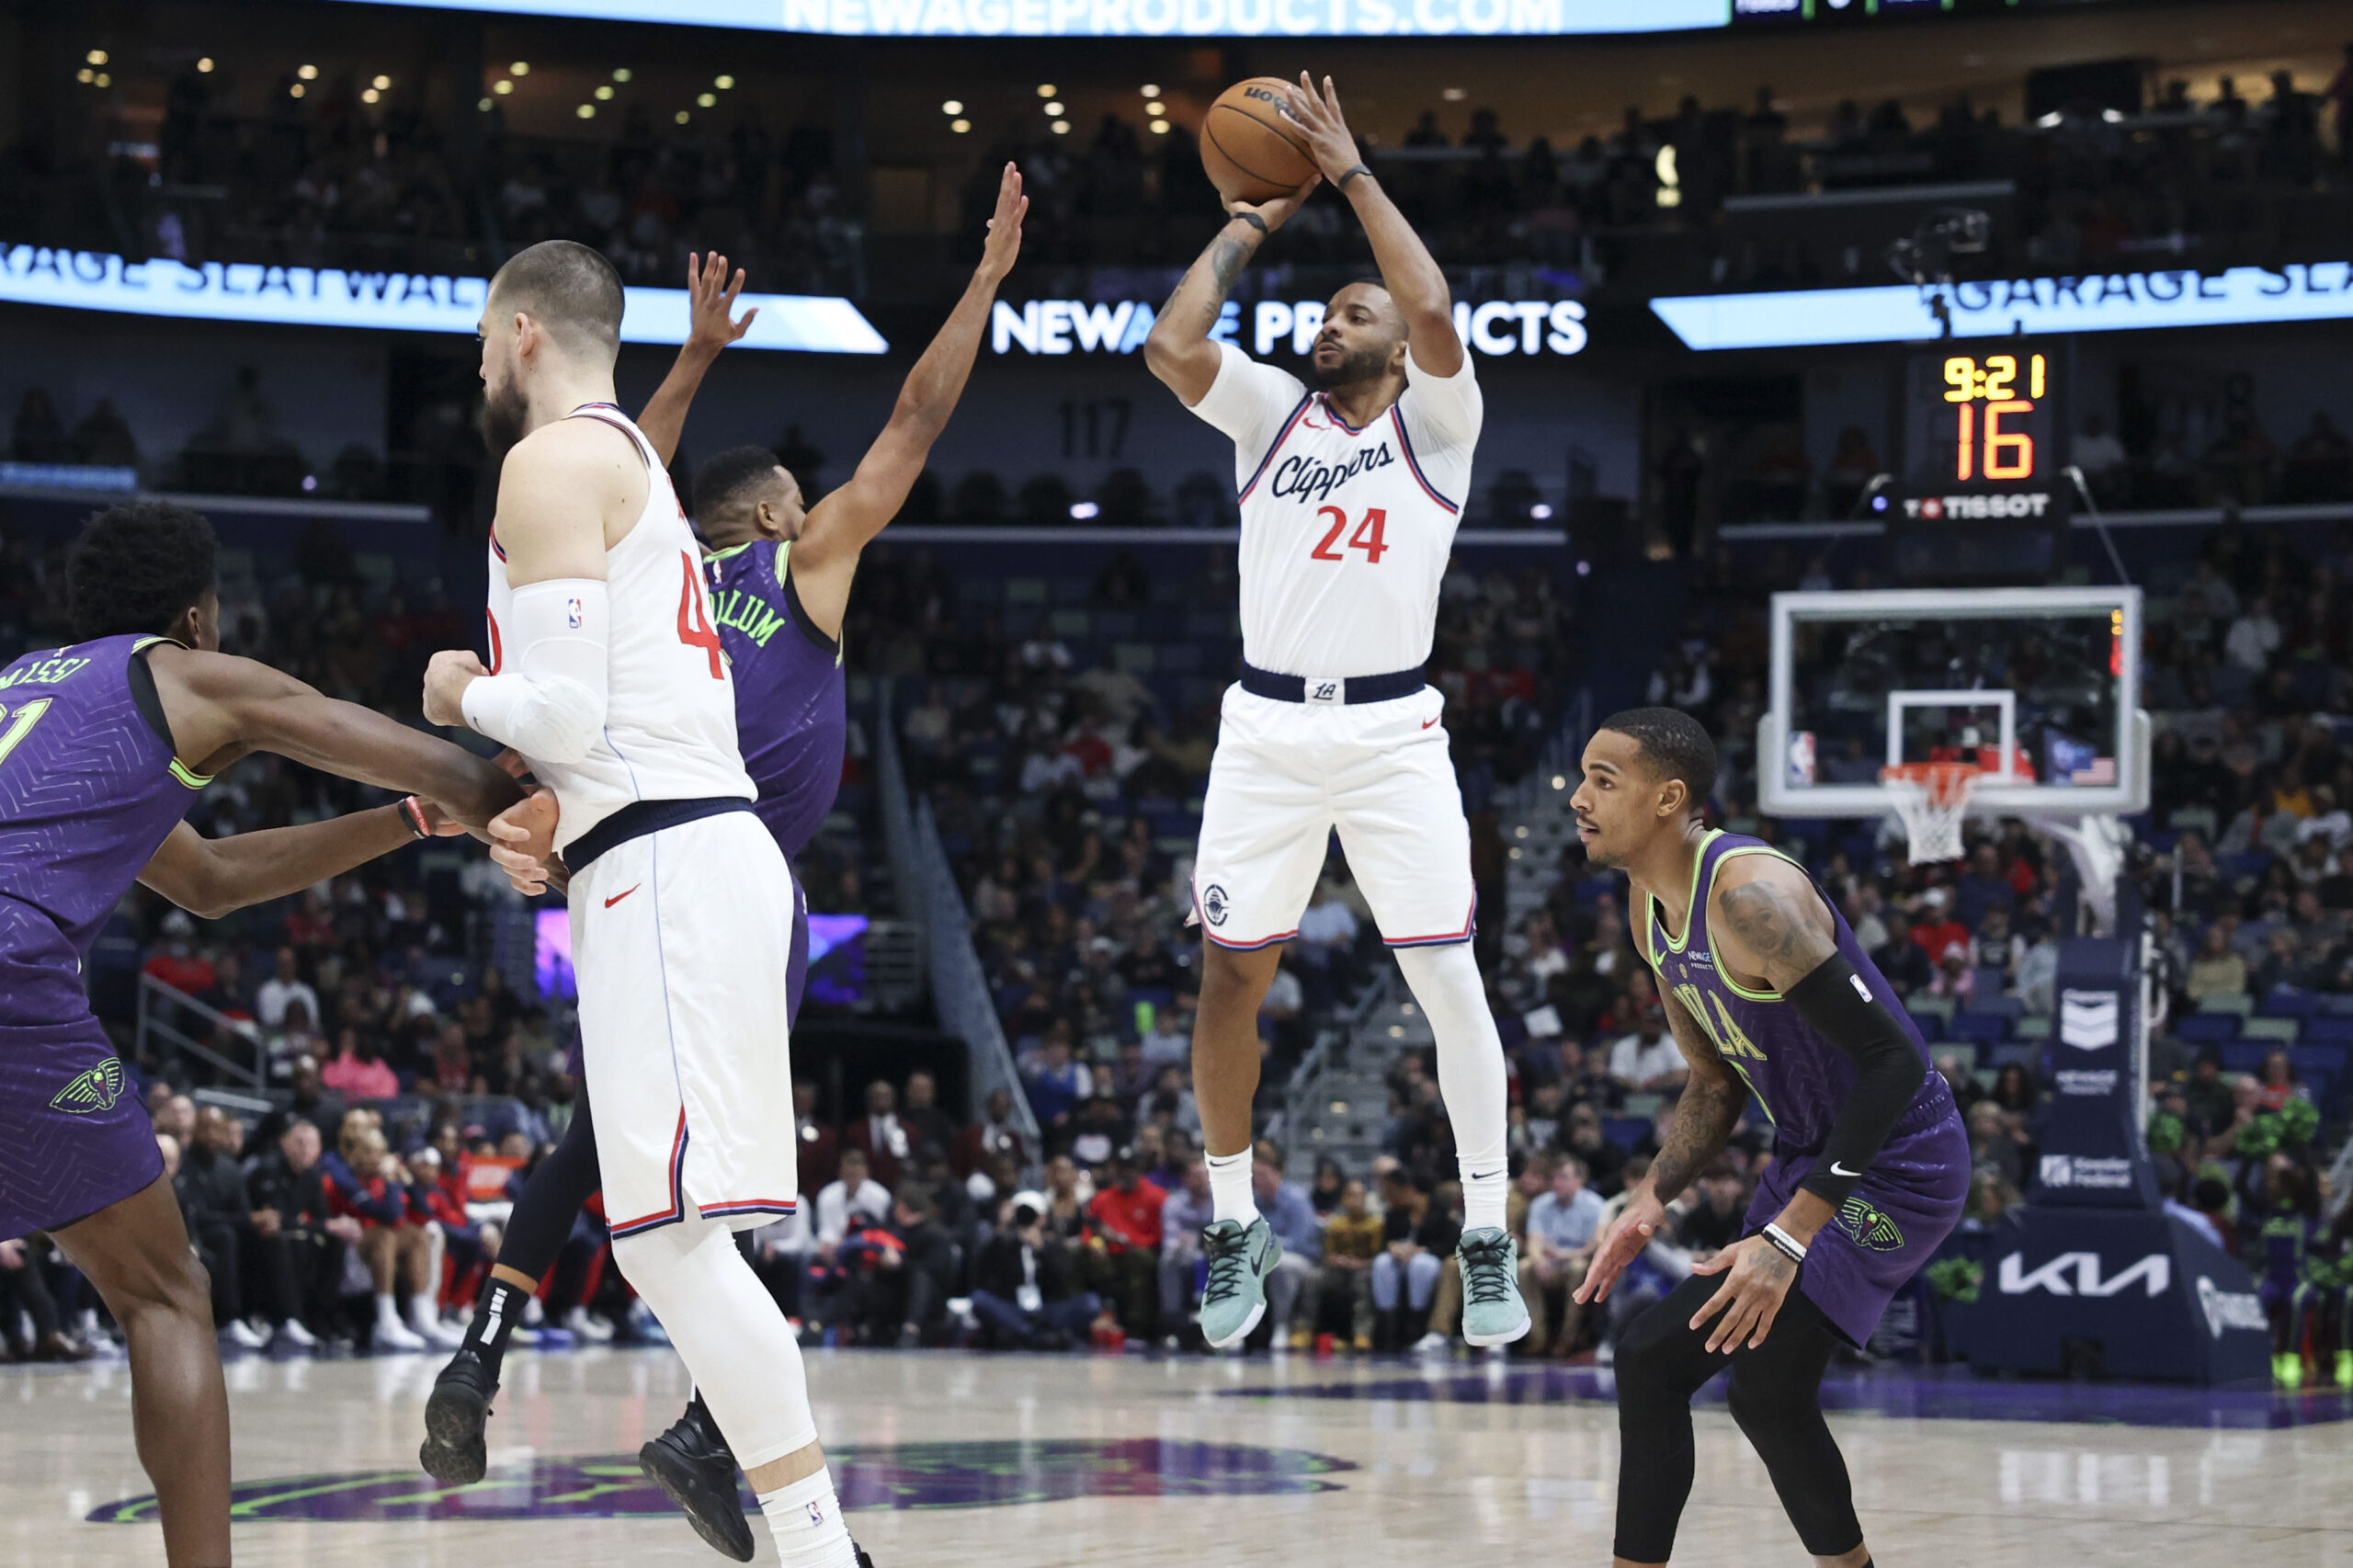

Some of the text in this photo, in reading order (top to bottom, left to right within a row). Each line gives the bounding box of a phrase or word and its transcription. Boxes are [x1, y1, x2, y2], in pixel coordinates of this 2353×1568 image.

[783, 0, 1563, 36] NEWAGEPRODUCTS.COM
[994, 300, 1588, 356] NEWAE PRCTS
[1944, 354, 2045, 402] 9:21
[1059, 397, 1132, 459] 117
[1958, 400, 2035, 481] 16
[1272, 441, 1395, 504] Clippers
[1311, 506, 1389, 563] 24
[1942, 493, 2050, 520] TISSOT
[1999, 1251, 2170, 1298] KIA
